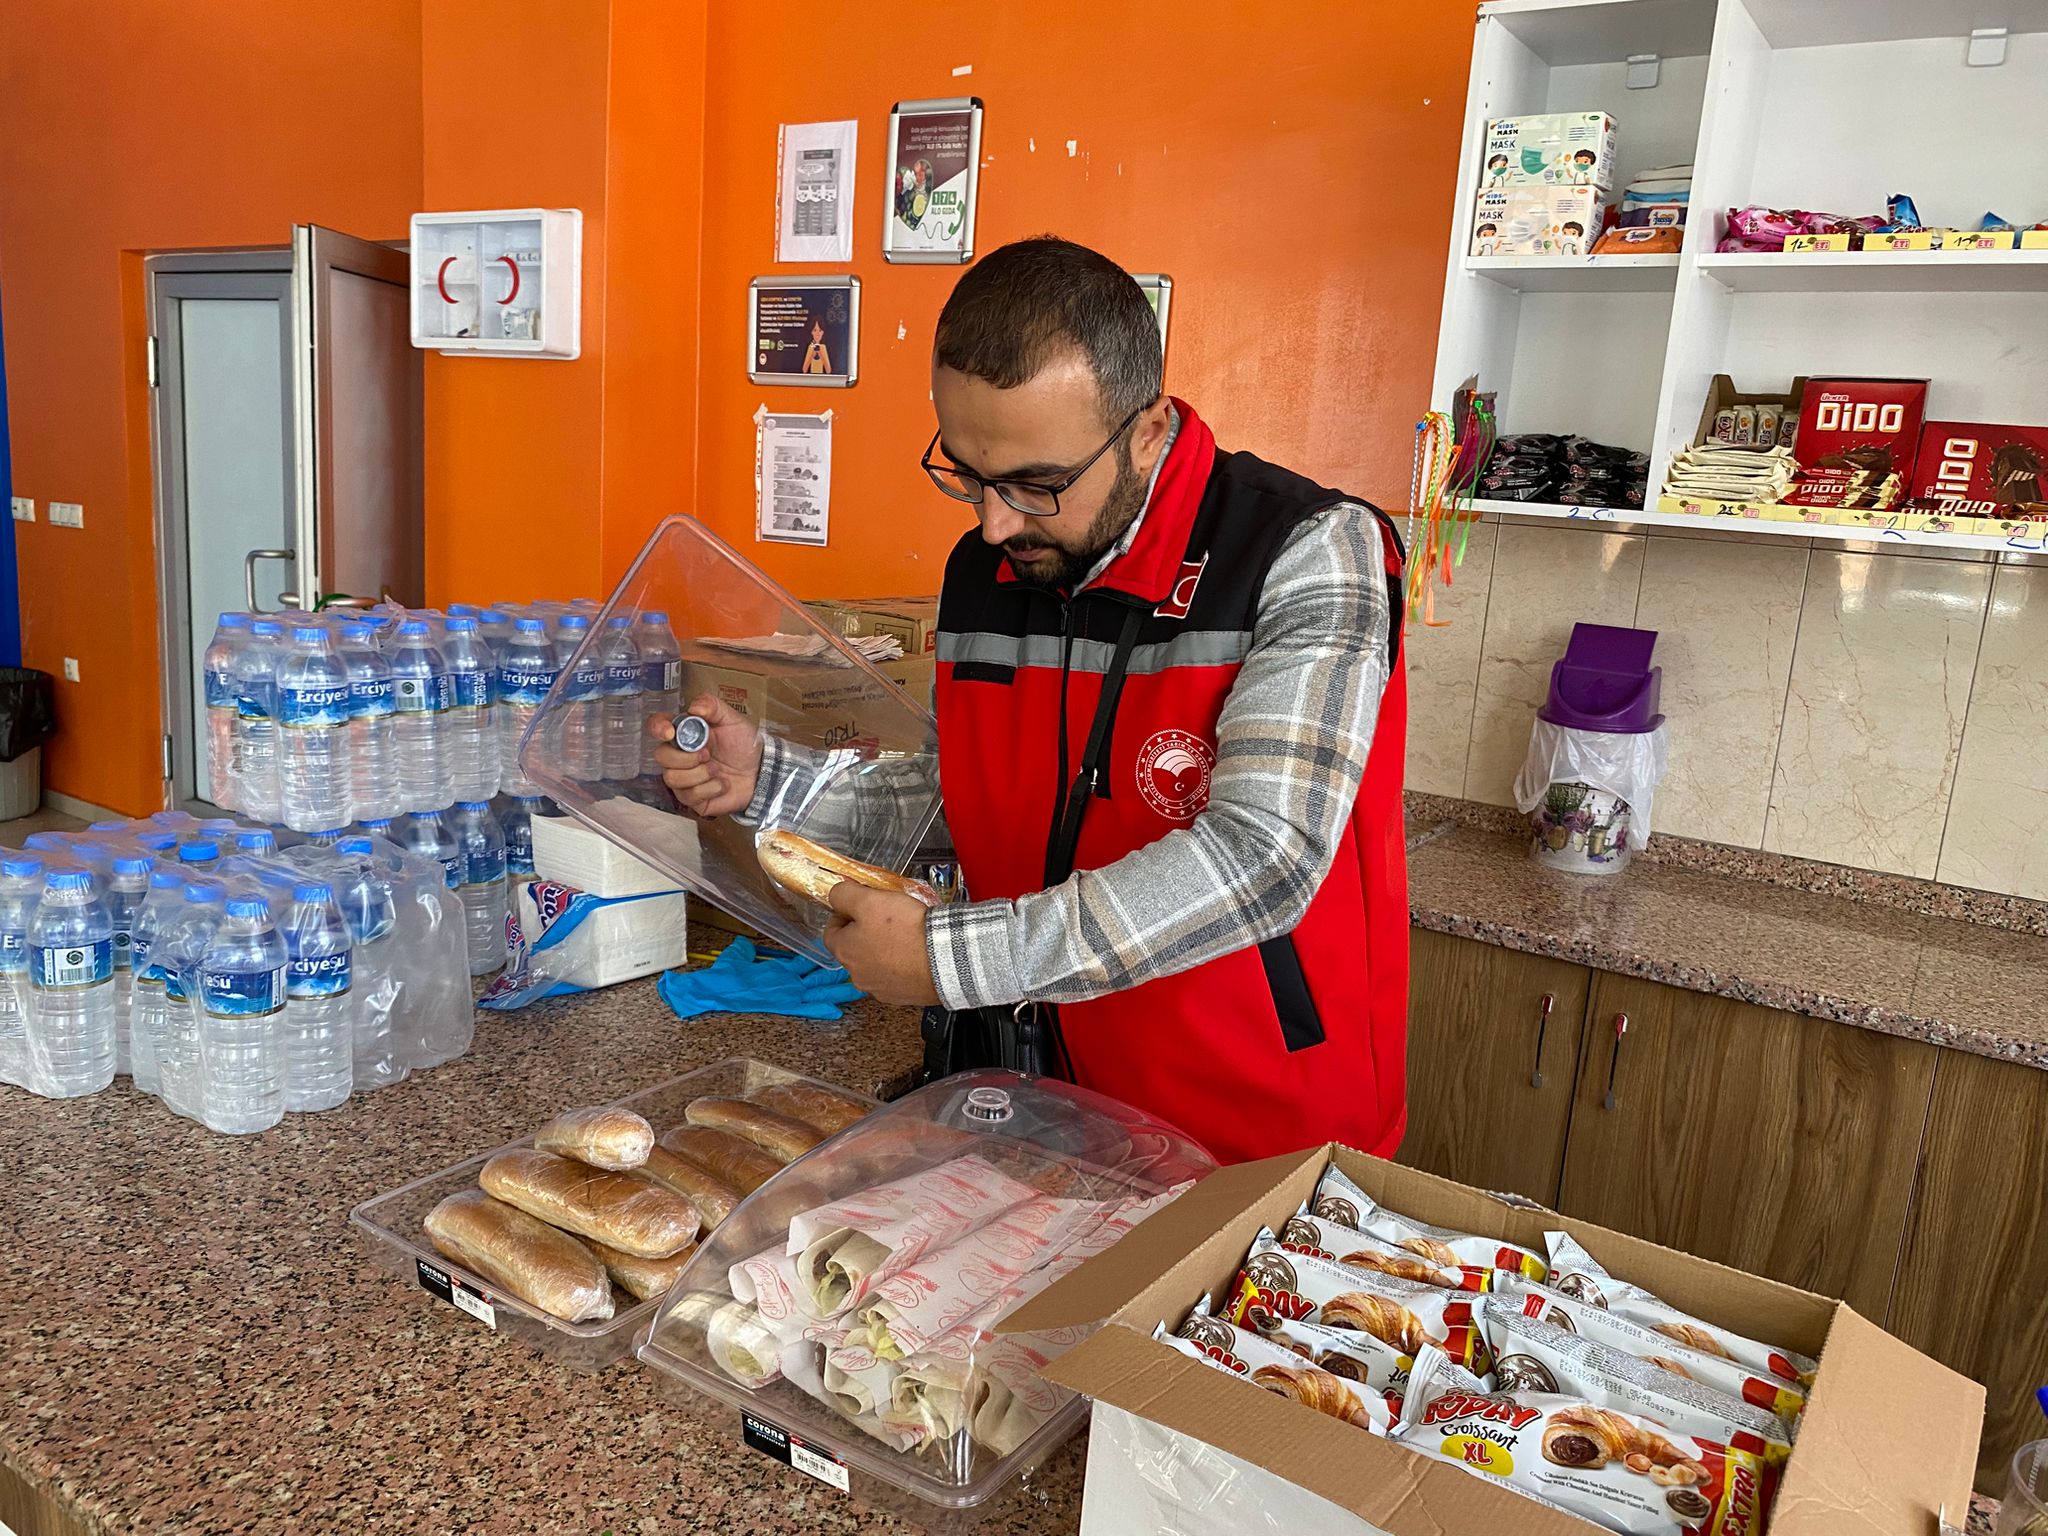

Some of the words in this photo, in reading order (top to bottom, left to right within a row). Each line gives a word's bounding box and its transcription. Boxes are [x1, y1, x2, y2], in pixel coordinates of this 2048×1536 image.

[1490, 139, 1516, 150] MASK
[1478, 211, 1504, 220] MASK
[502, 671, 552, 687] ErciyeSu
[824, 720, 860, 746] TRIO
[420, 1262, 448, 1283] corona
[747, 1418, 785, 1442] corona
[1440, 1421, 1519, 1452] Croissant
[1462, 1441, 1494, 1465] XL
